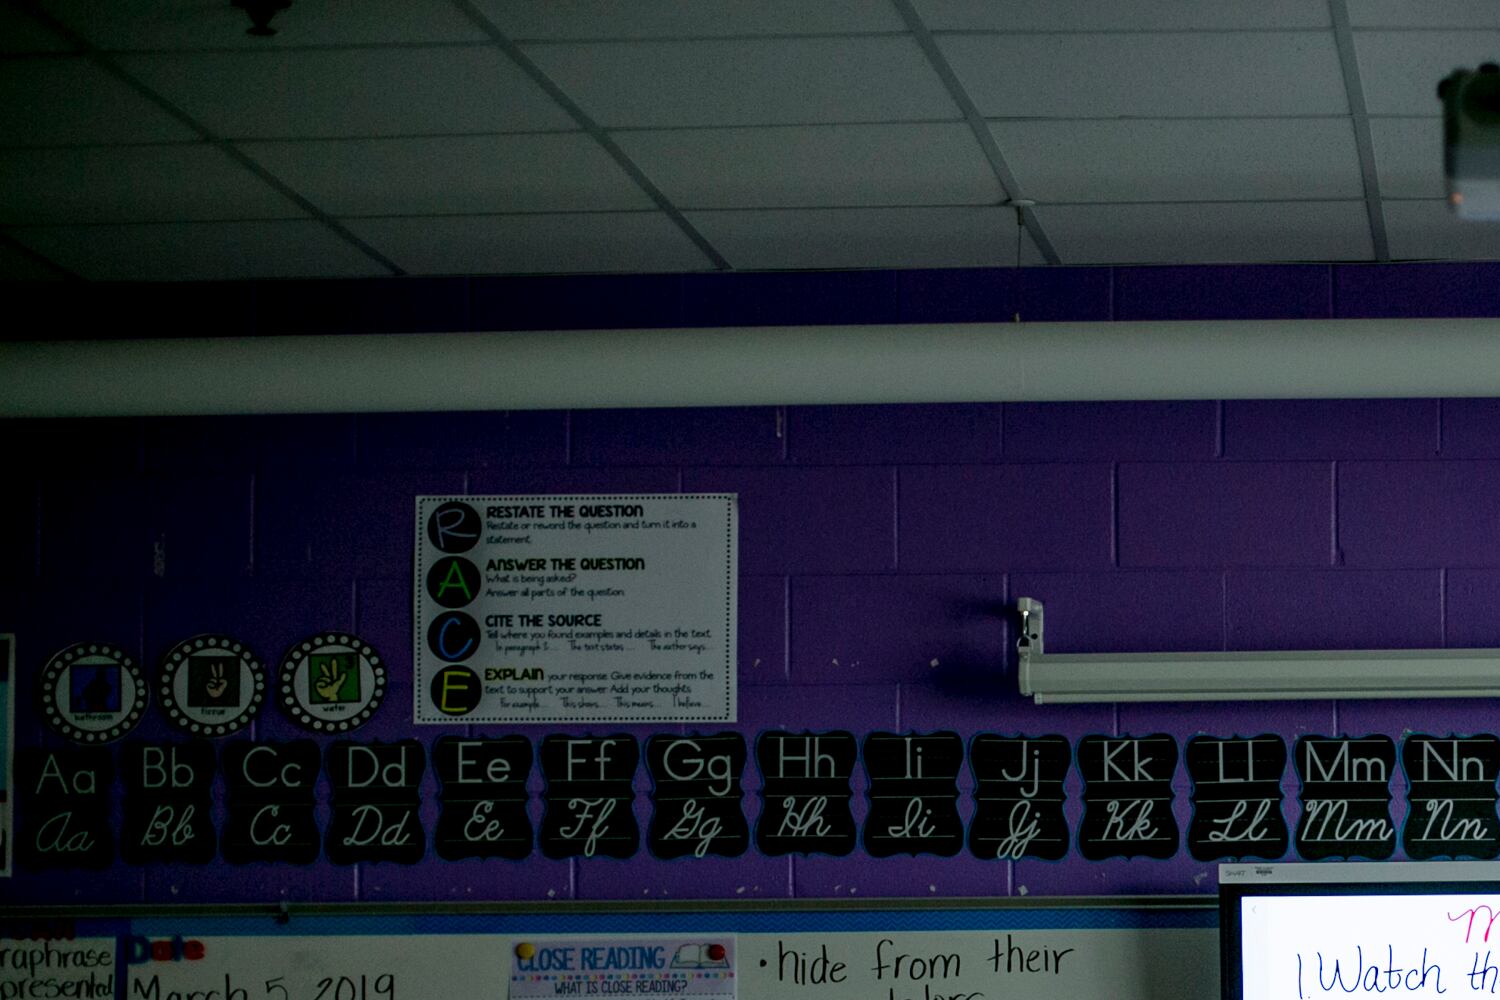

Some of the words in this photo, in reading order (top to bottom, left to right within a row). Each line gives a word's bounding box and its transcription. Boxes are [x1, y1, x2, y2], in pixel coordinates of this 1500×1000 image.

[486, 505, 545, 518] RESTATE
[549, 505, 575, 518] THE
[579, 504, 643, 518] QUESTION
[486, 559, 546, 571] ANSWER
[551, 559, 575, 571] THE
[580, 558, 645, 571] QUESTION
[485, 615, 514, 627] CITE
[519, 615, 543, 627] THE
[548, 614, 602, 627] SOURCE
[484, 668, 544, 681] EXPLAIN
[143, 746, 194, 788] Bb
[347, 746, 406, 788] Dd
[567, 741, 616, 782] Ff
[1103, 741, 1153, 782] Kk
[1306, 741, 1386, 782] Mm
[581, 947, 665, 970] READING
[777, 941, 847, 986] hide
[871, 939, 960, 981] from
[987, 935, 1074, 975] their
[1317, 945, 1446, 994] Watch
[555, 981, 581, 994] WHAT
[586, 981, 598, 993] IS
[601, 980, 633, 993] CLOSE
[636, 980, 688, 993] READING?
